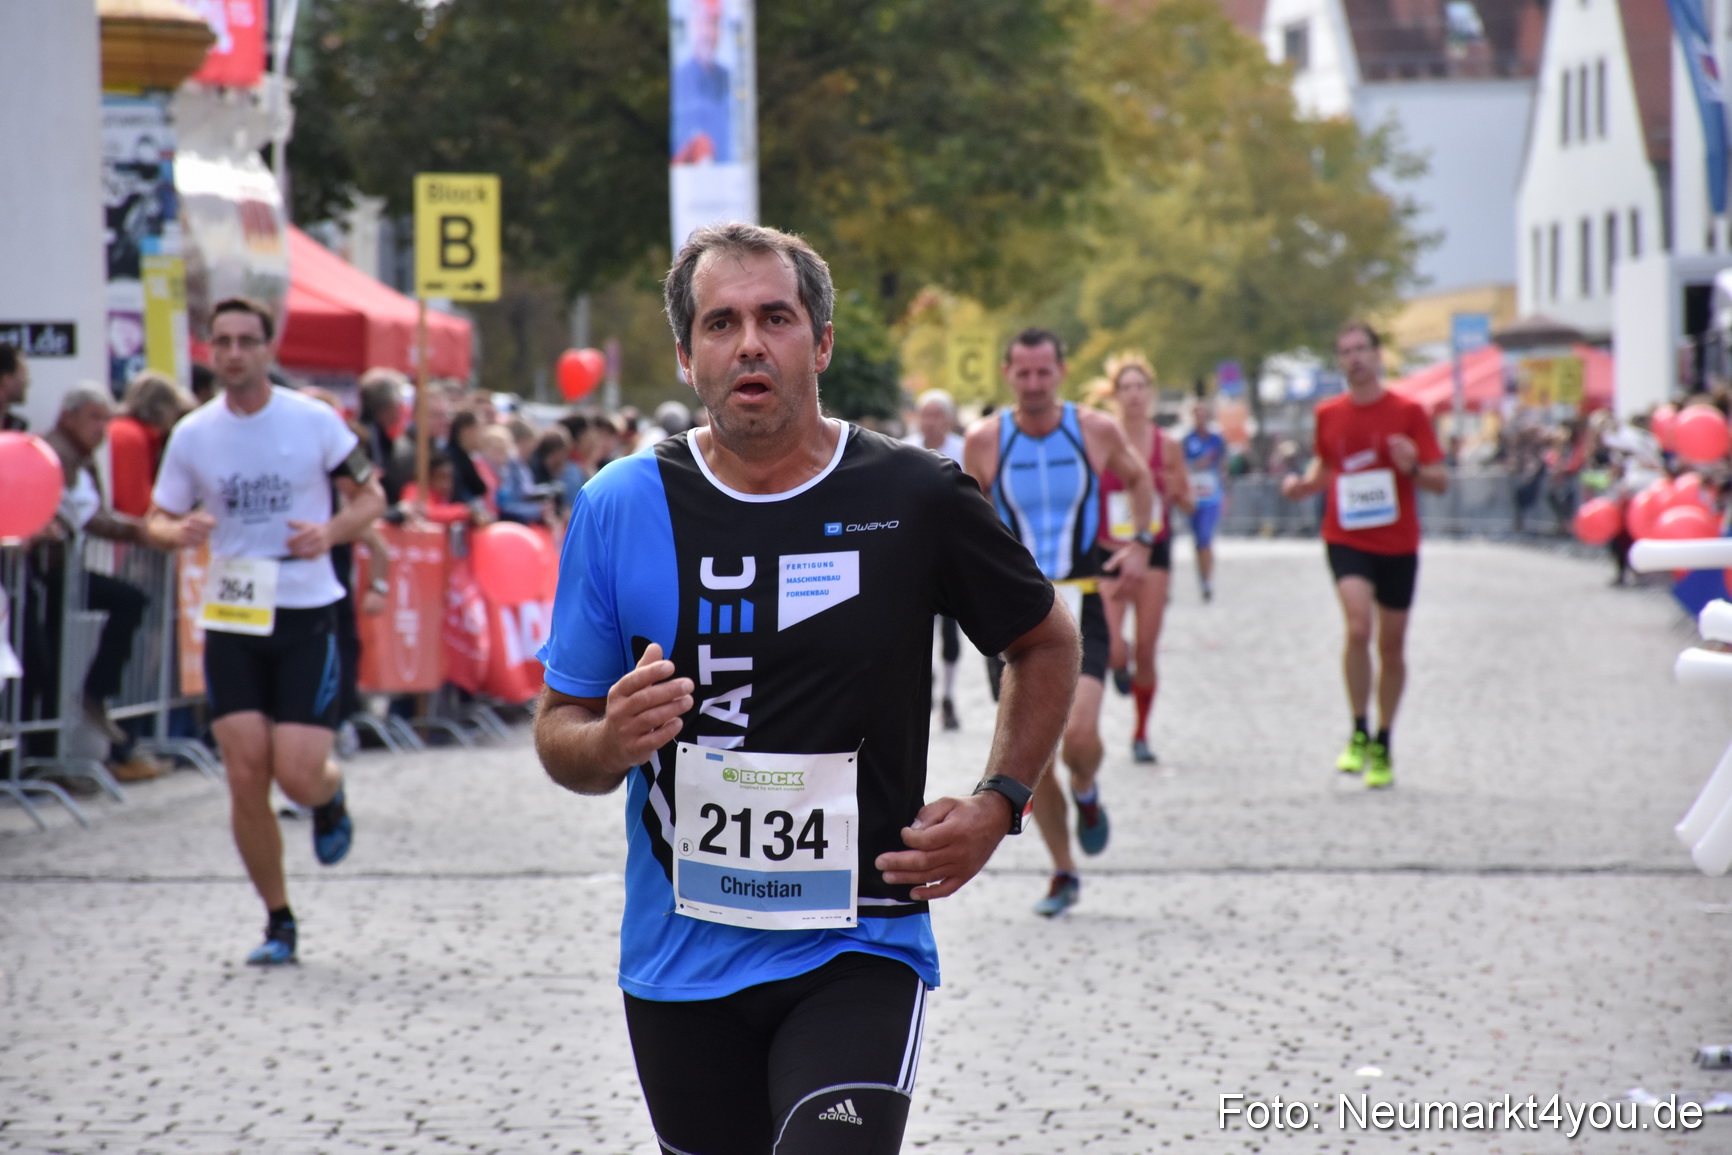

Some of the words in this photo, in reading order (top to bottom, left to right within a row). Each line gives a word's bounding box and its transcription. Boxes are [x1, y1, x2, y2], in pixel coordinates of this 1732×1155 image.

[426, 182, 487, 204] Block
[439, 214, 476, 270] B
[957, 349, 984, 383] C
[786, 561, 834, 571] FERTIGUNG
[218, 576, 255, 603] 264
[786, 575, 841, 584] MASCHINENBAU
[786, 589, 830, 598] FORMENBAU
[697, 556, 757, 750] ATEC
[740, 769, 805, 786] BOCK
[698, 803, 829, 861] 2134
[683, 842, 689, 852] B
[720, 875, 802, 898] Christian
[818, 1111, 863, 1126] adidas
